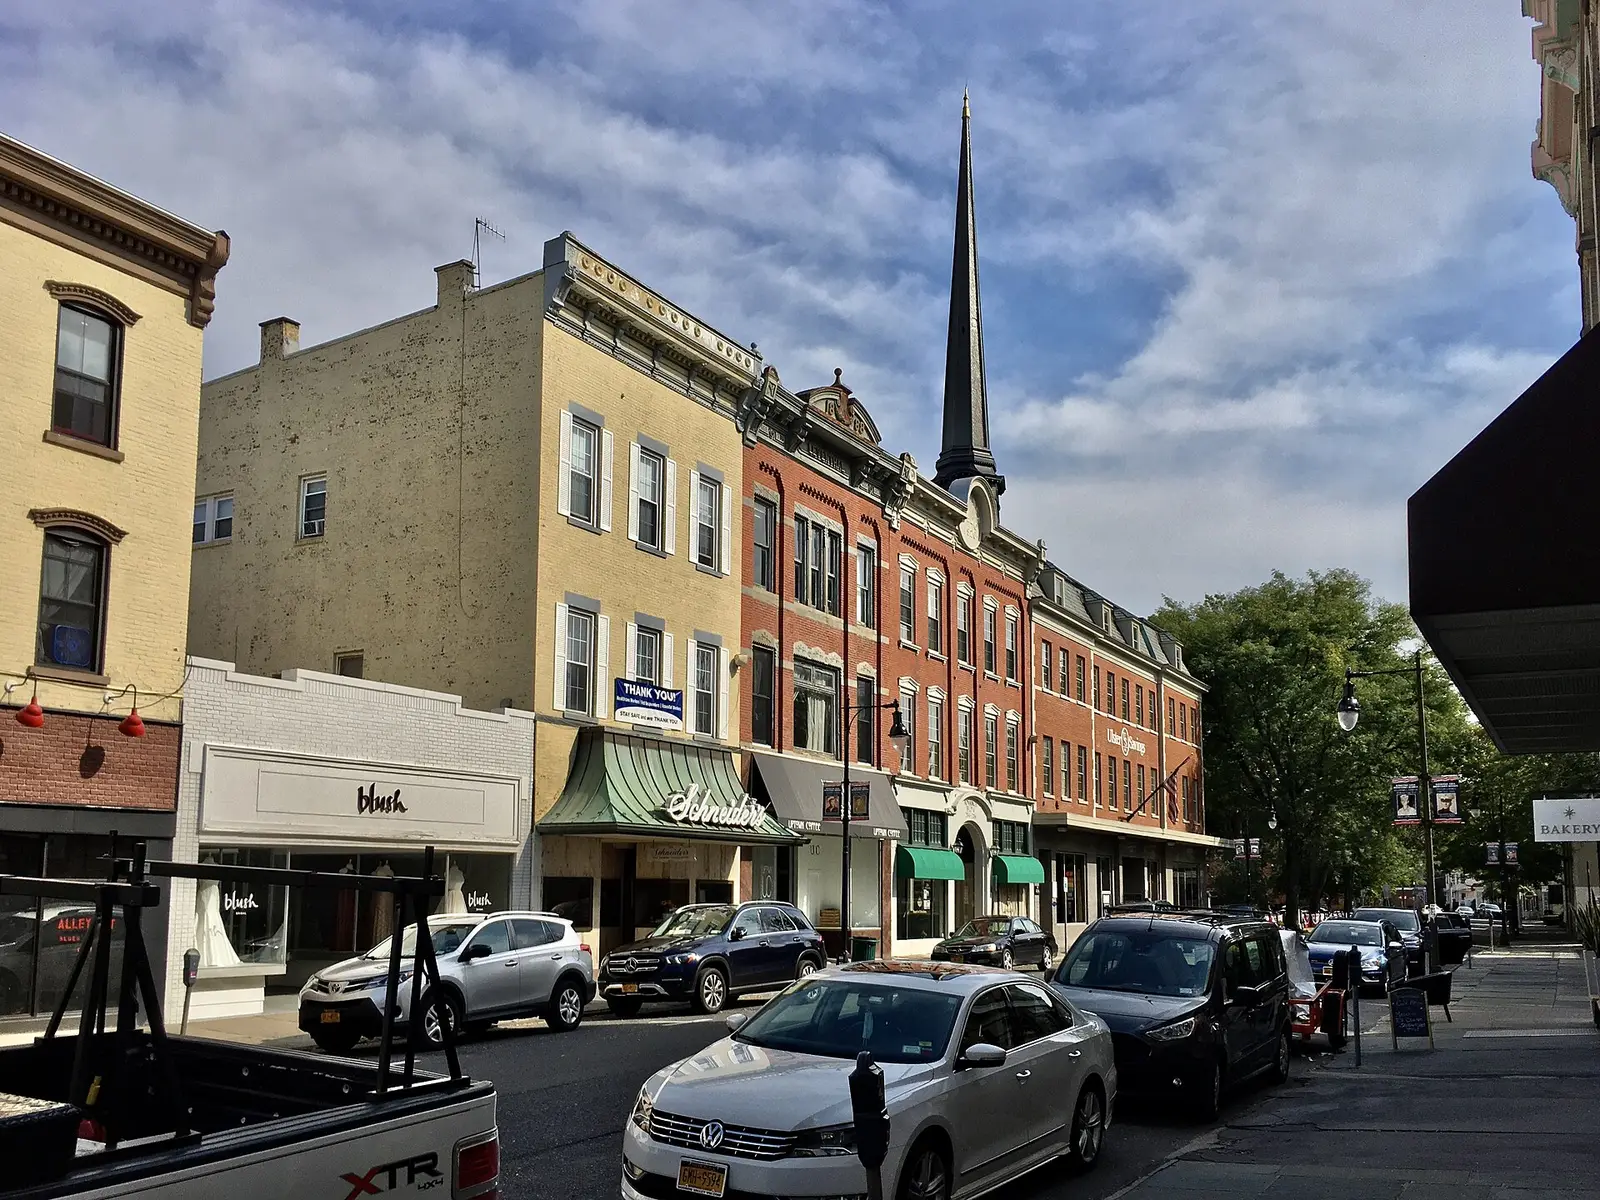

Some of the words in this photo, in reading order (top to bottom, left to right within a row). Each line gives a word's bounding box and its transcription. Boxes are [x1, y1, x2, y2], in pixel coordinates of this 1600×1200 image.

[624, 683, 652, 698] THANK
[653, 689, 676, 702] YOU!
[357, 782, 408, 815] blush
[805, 822, 821, 831] COFFEE
[1540, 824, 1600, 834] BAKERY
[224, 890, 259, 911] blush
[468, 890, 492, 907] blush
[57, 917, 92, 930] ALLEY
[339, 1151, 444, 1200] XTR
